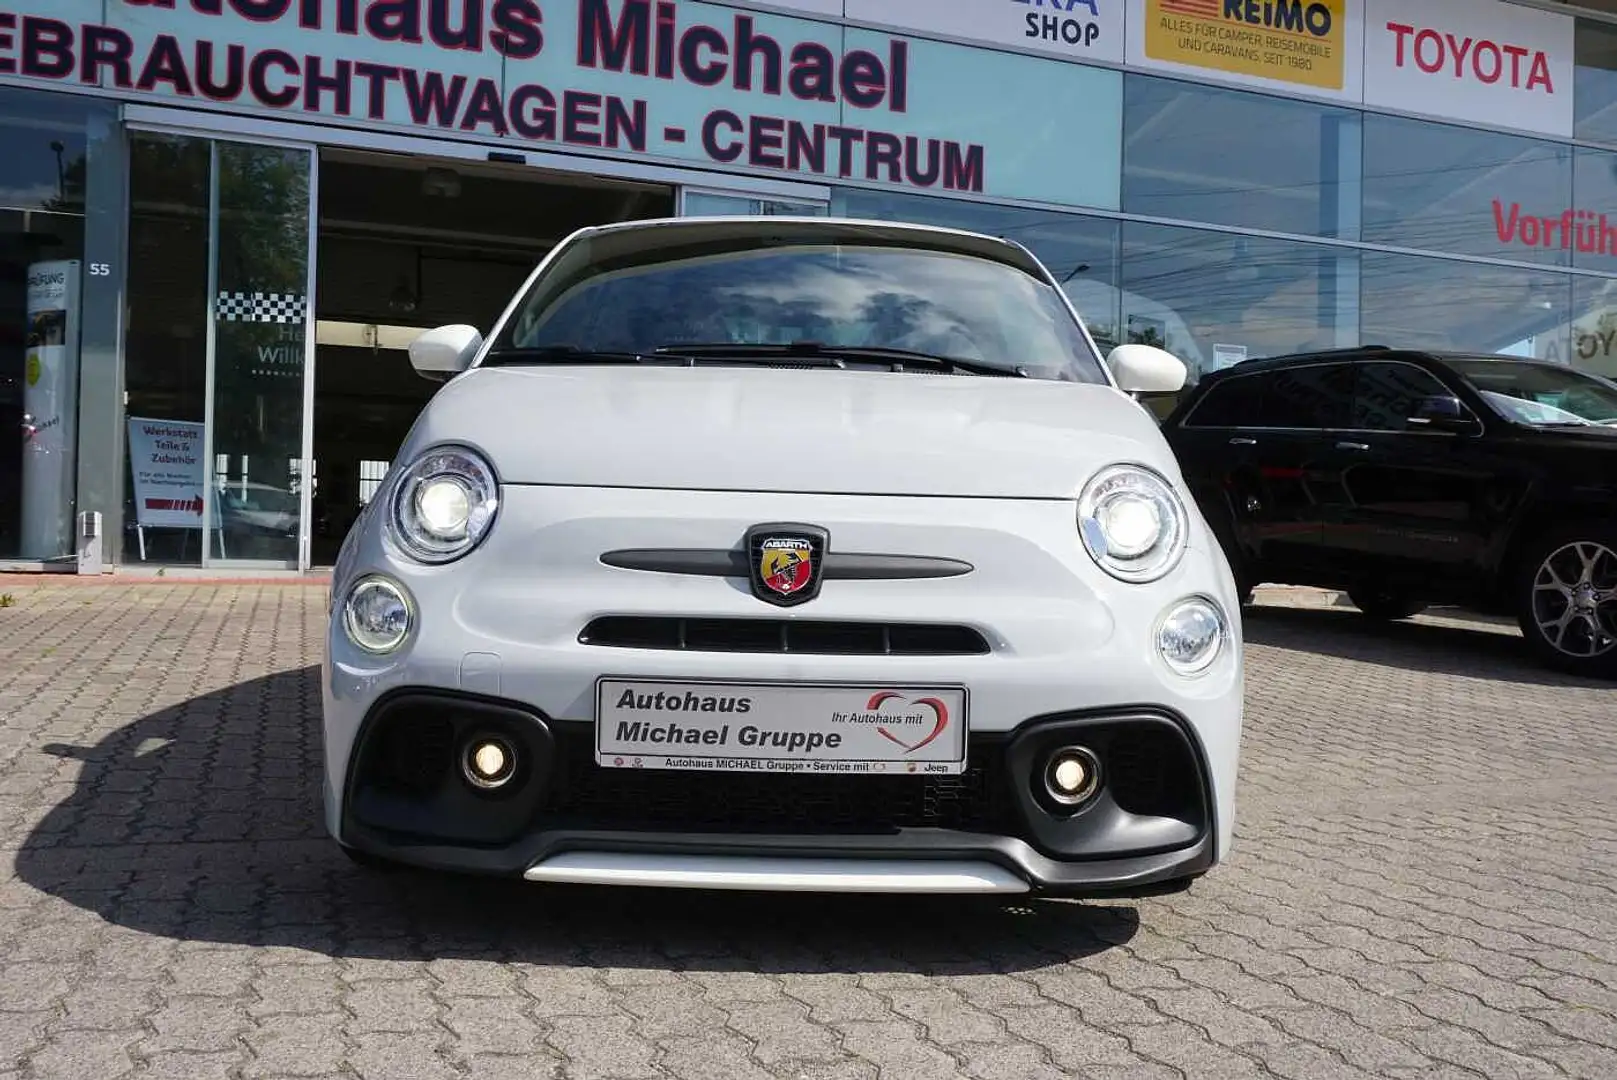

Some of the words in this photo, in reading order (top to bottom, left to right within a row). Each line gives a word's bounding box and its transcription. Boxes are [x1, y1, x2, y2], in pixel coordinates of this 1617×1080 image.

[1025, 12, 1100, 47] SHOP
[1160, 17, 1194, 35] ALLES
[1265, 37, 1332, 59] REISEMOBILE
[577, 0, 908, 113] Michael
[1178, 38, 1202, 51] UND
[1264, 55, 1285, 67] SEIT
[1386, 21, 1553, 94] TOYOTA
[702, 108, 984, 192] CENTRUM
[89, 263, 110, 276] 55
[765, 541, 808, 549] ABARTH
[615, 688, 752, 713] Autohaus
[831, 711, 848, 723] Ihr
[848, 712, 902, 724] Autohaus
[905, 713, 923, 725] mit
[615, 721, 729, 745] Michael
[737, 725, 842, 752] Gruppe
[665, 757, 713, 769] Autohaus
[716, 759, 763, 770] MICHAEL
[766, 760, 804, 772] Gruppe
[813, 761, 851, 771] Service
[853, 761, 870, 771] mit
[923, 763, 949, 773] Jeep
